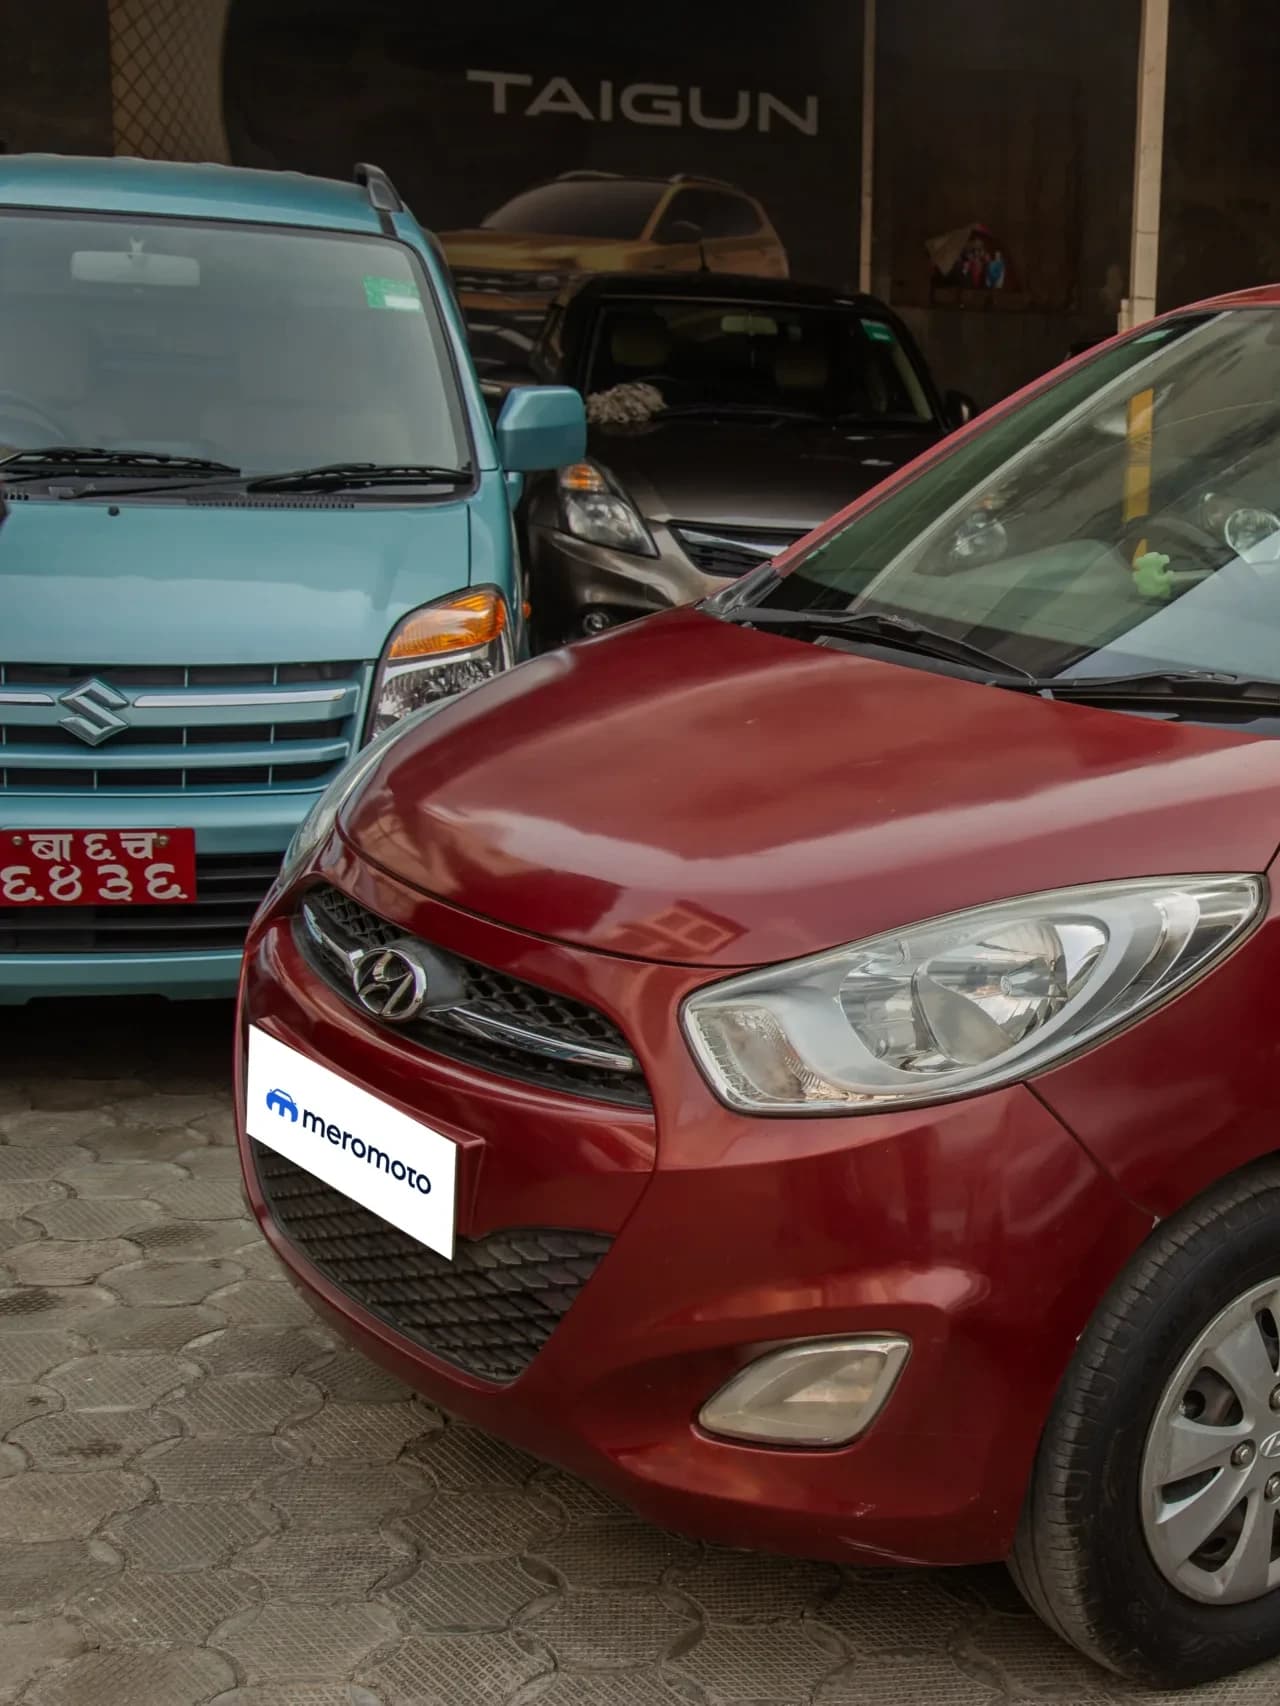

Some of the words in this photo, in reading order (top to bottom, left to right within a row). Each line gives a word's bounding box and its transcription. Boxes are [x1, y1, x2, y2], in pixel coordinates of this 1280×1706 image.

[466, 69, 819, 136] TAIGUN
[28, 833, 74, 862] बा
[83, 833, 117, 861] ६
[119, 832, 158, 860] च
[0, 862, 189, 902] ६४३६
